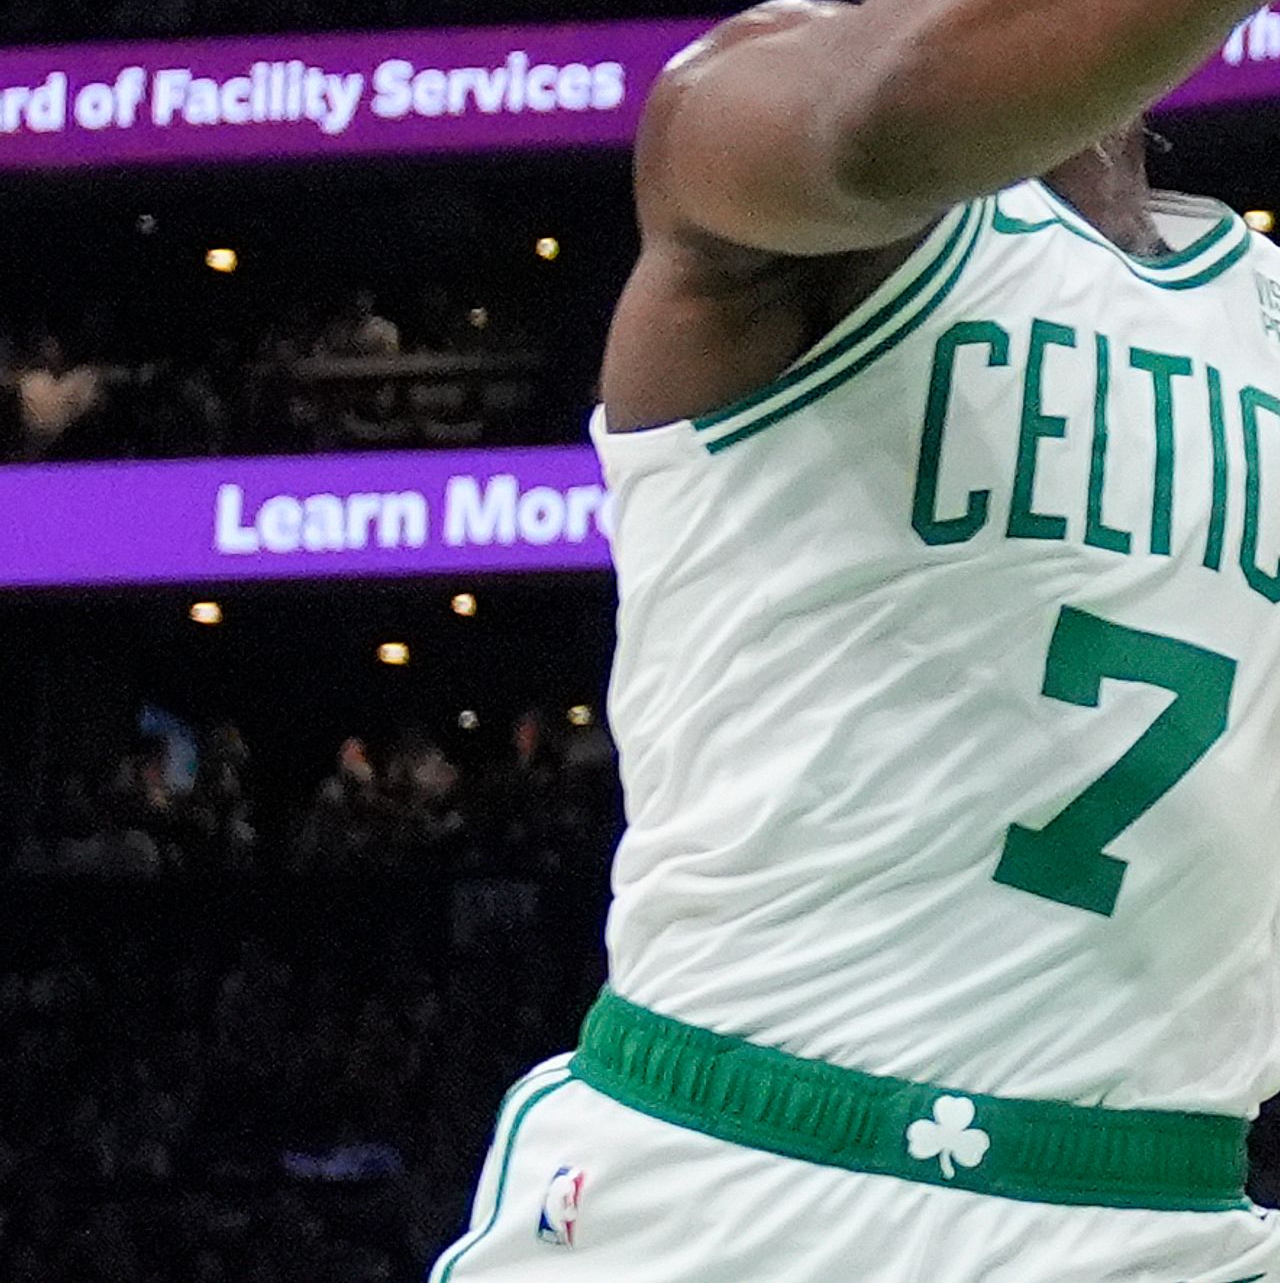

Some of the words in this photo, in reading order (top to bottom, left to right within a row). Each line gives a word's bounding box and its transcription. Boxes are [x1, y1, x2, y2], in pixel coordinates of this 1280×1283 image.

[75, 67, 145, 129] of
[152, 59, 363, 134] Facility
[371, 51, 625, 117] Services
[215, 484, 428, 554] Learn
[443, 475, 613, 546] Mor
[991, 604, 1238, 918] 7
